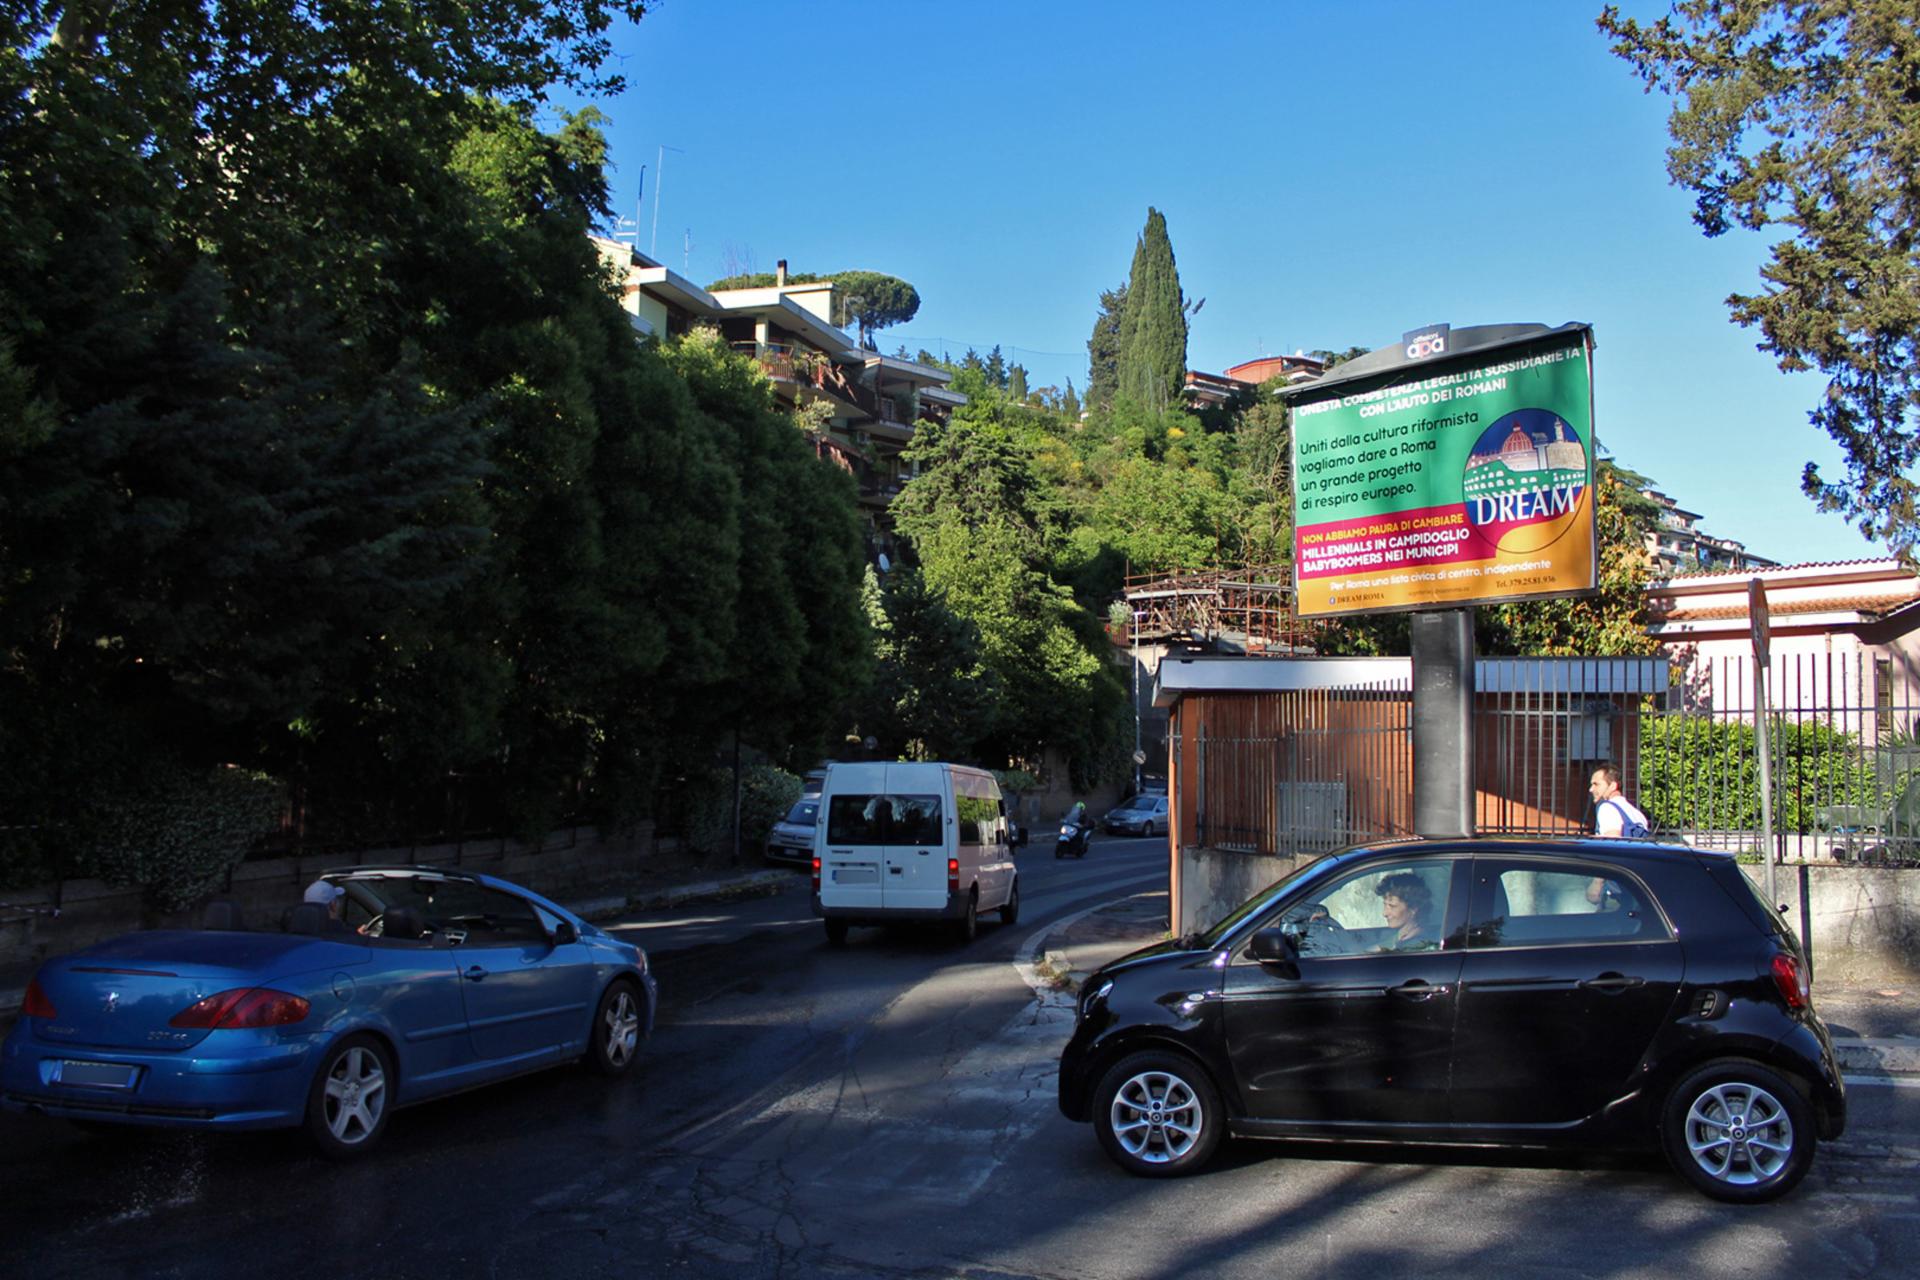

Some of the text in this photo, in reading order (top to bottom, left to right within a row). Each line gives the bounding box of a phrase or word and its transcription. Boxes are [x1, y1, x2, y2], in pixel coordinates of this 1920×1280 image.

[1407, 337, 1444, 359] apa
[1360, 404, 1385, 418] CON
[1432, 388, 1453, 403] DEI
[1456, 378, 1507, 398] ROMANI
[1301, 412, 1479, 455] Uniti dalla cultura riformista
[1301, 440, 1437, 474] vogliamo dare a Roma
[1302, 461, 1422, 492] un grande progetto
[1302, 483, 1416, 510] di respiro europeo.
[1477, 482, 1575, 525] DREAM
[1302, 513, 1464, 545] NON ABBIAMO PAURA DI CAMBIARE
[1302, 528, 1470, 560] MILLENNIALS IN CAMPIDOGLIO
[1303, 543, 1459, 573] BABYBOOMERS NEI MUNICIPI
[1329, 581, 1345, 591] Per
[1346, 580, 1370, 590] Roma
[1372, 577, 1390, 586] una
[1391, 574, 1409, 584] lista
[1411, 572, 1436, 582] civica
[1437, 570, 1447, 580] di
[1484, 559, 1552, 576] indipendente
